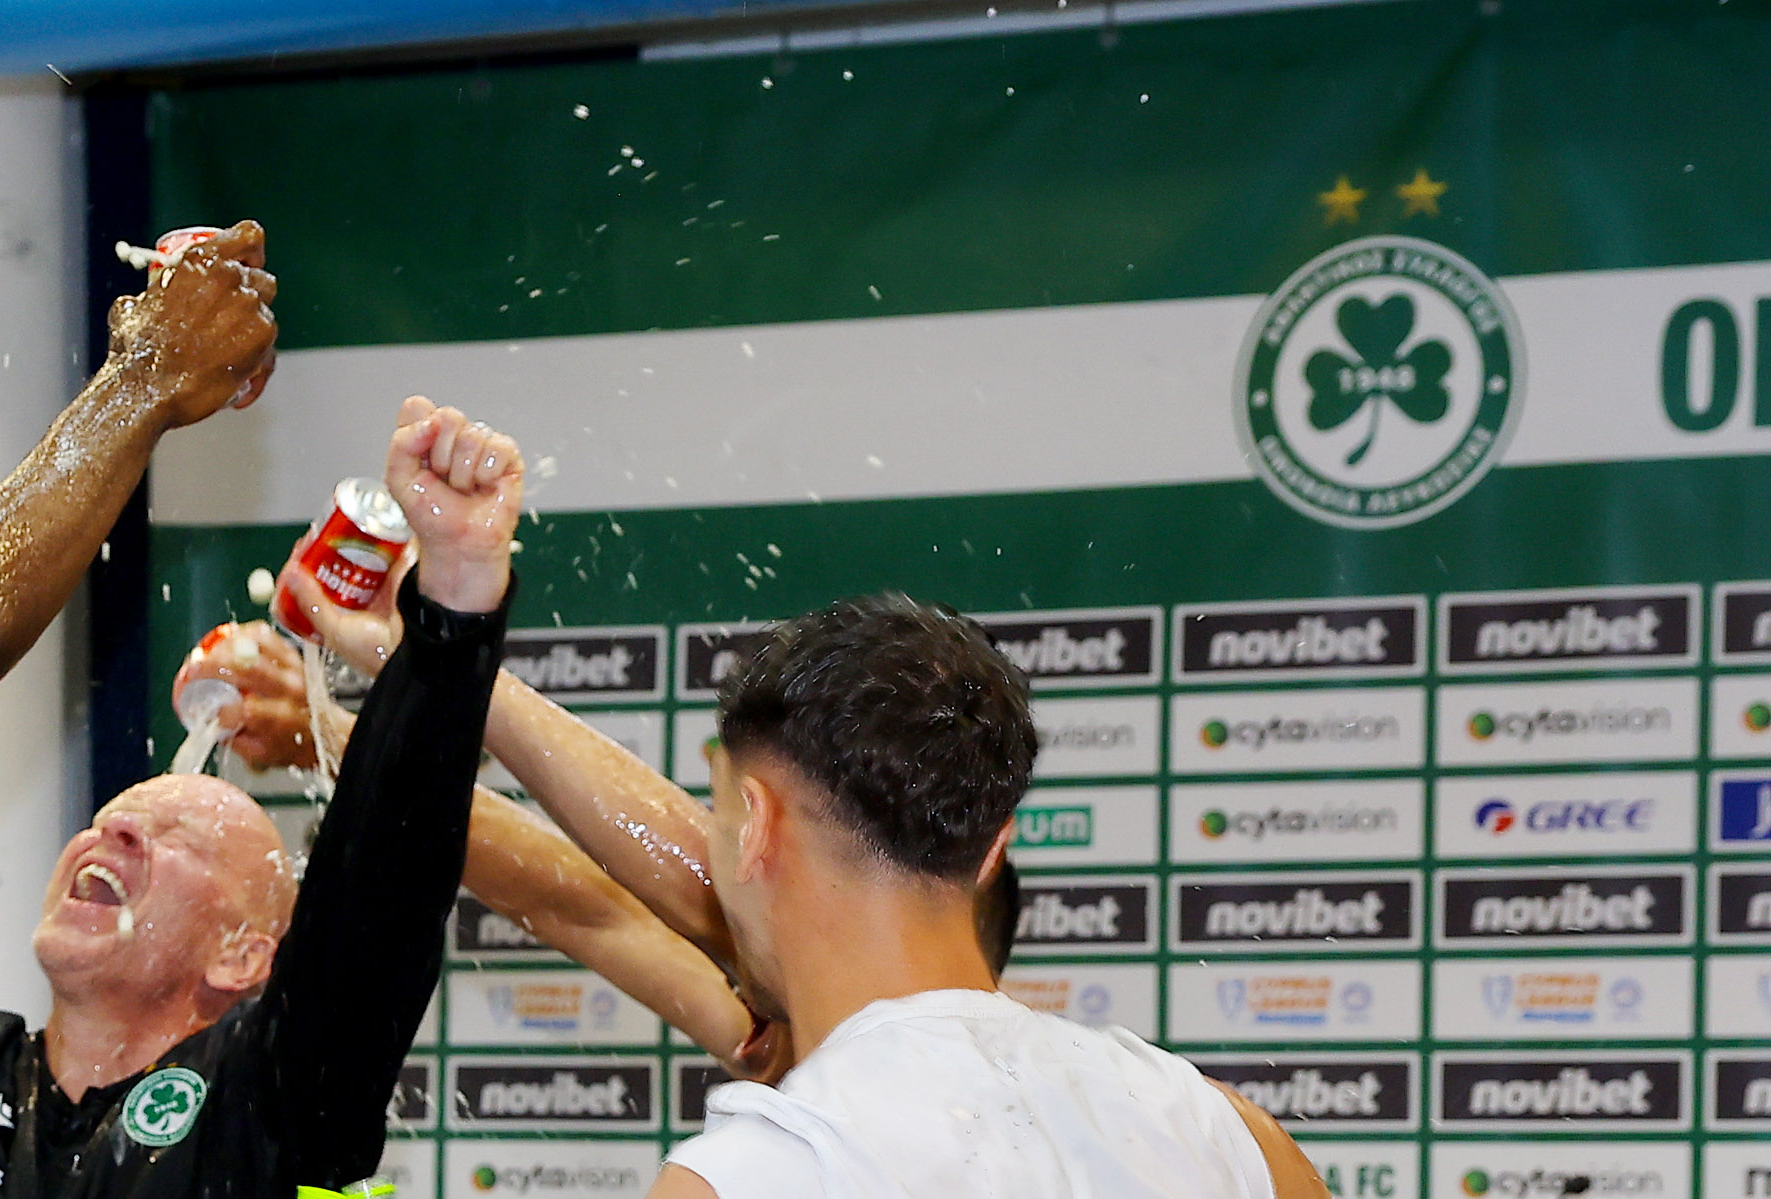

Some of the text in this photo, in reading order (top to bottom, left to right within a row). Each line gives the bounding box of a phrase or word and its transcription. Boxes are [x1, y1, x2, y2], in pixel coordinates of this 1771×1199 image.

[1208, 617, 1388, 665] novibet
[1472, 605, 1661, 656] novibet
[1231, 709, 1400, 751] cytavision
[1501, 700, 1672, 743] cytavision
[1011, 811, 1090, 844] um
[1231, 803, 1398, 840] cytavision
[1527, 799, 1655, 834] GREE
[1205, 890, 1384, 937] novibet
[1469, 883, 1656, 930] novibet
[480, 1071, 627, 1116] novibet
[1467, 1067, 1652, 1115] novibet
[500, 1164, 640, 1195] cytavision
[1356, 1162, 1395, 1198] FC
